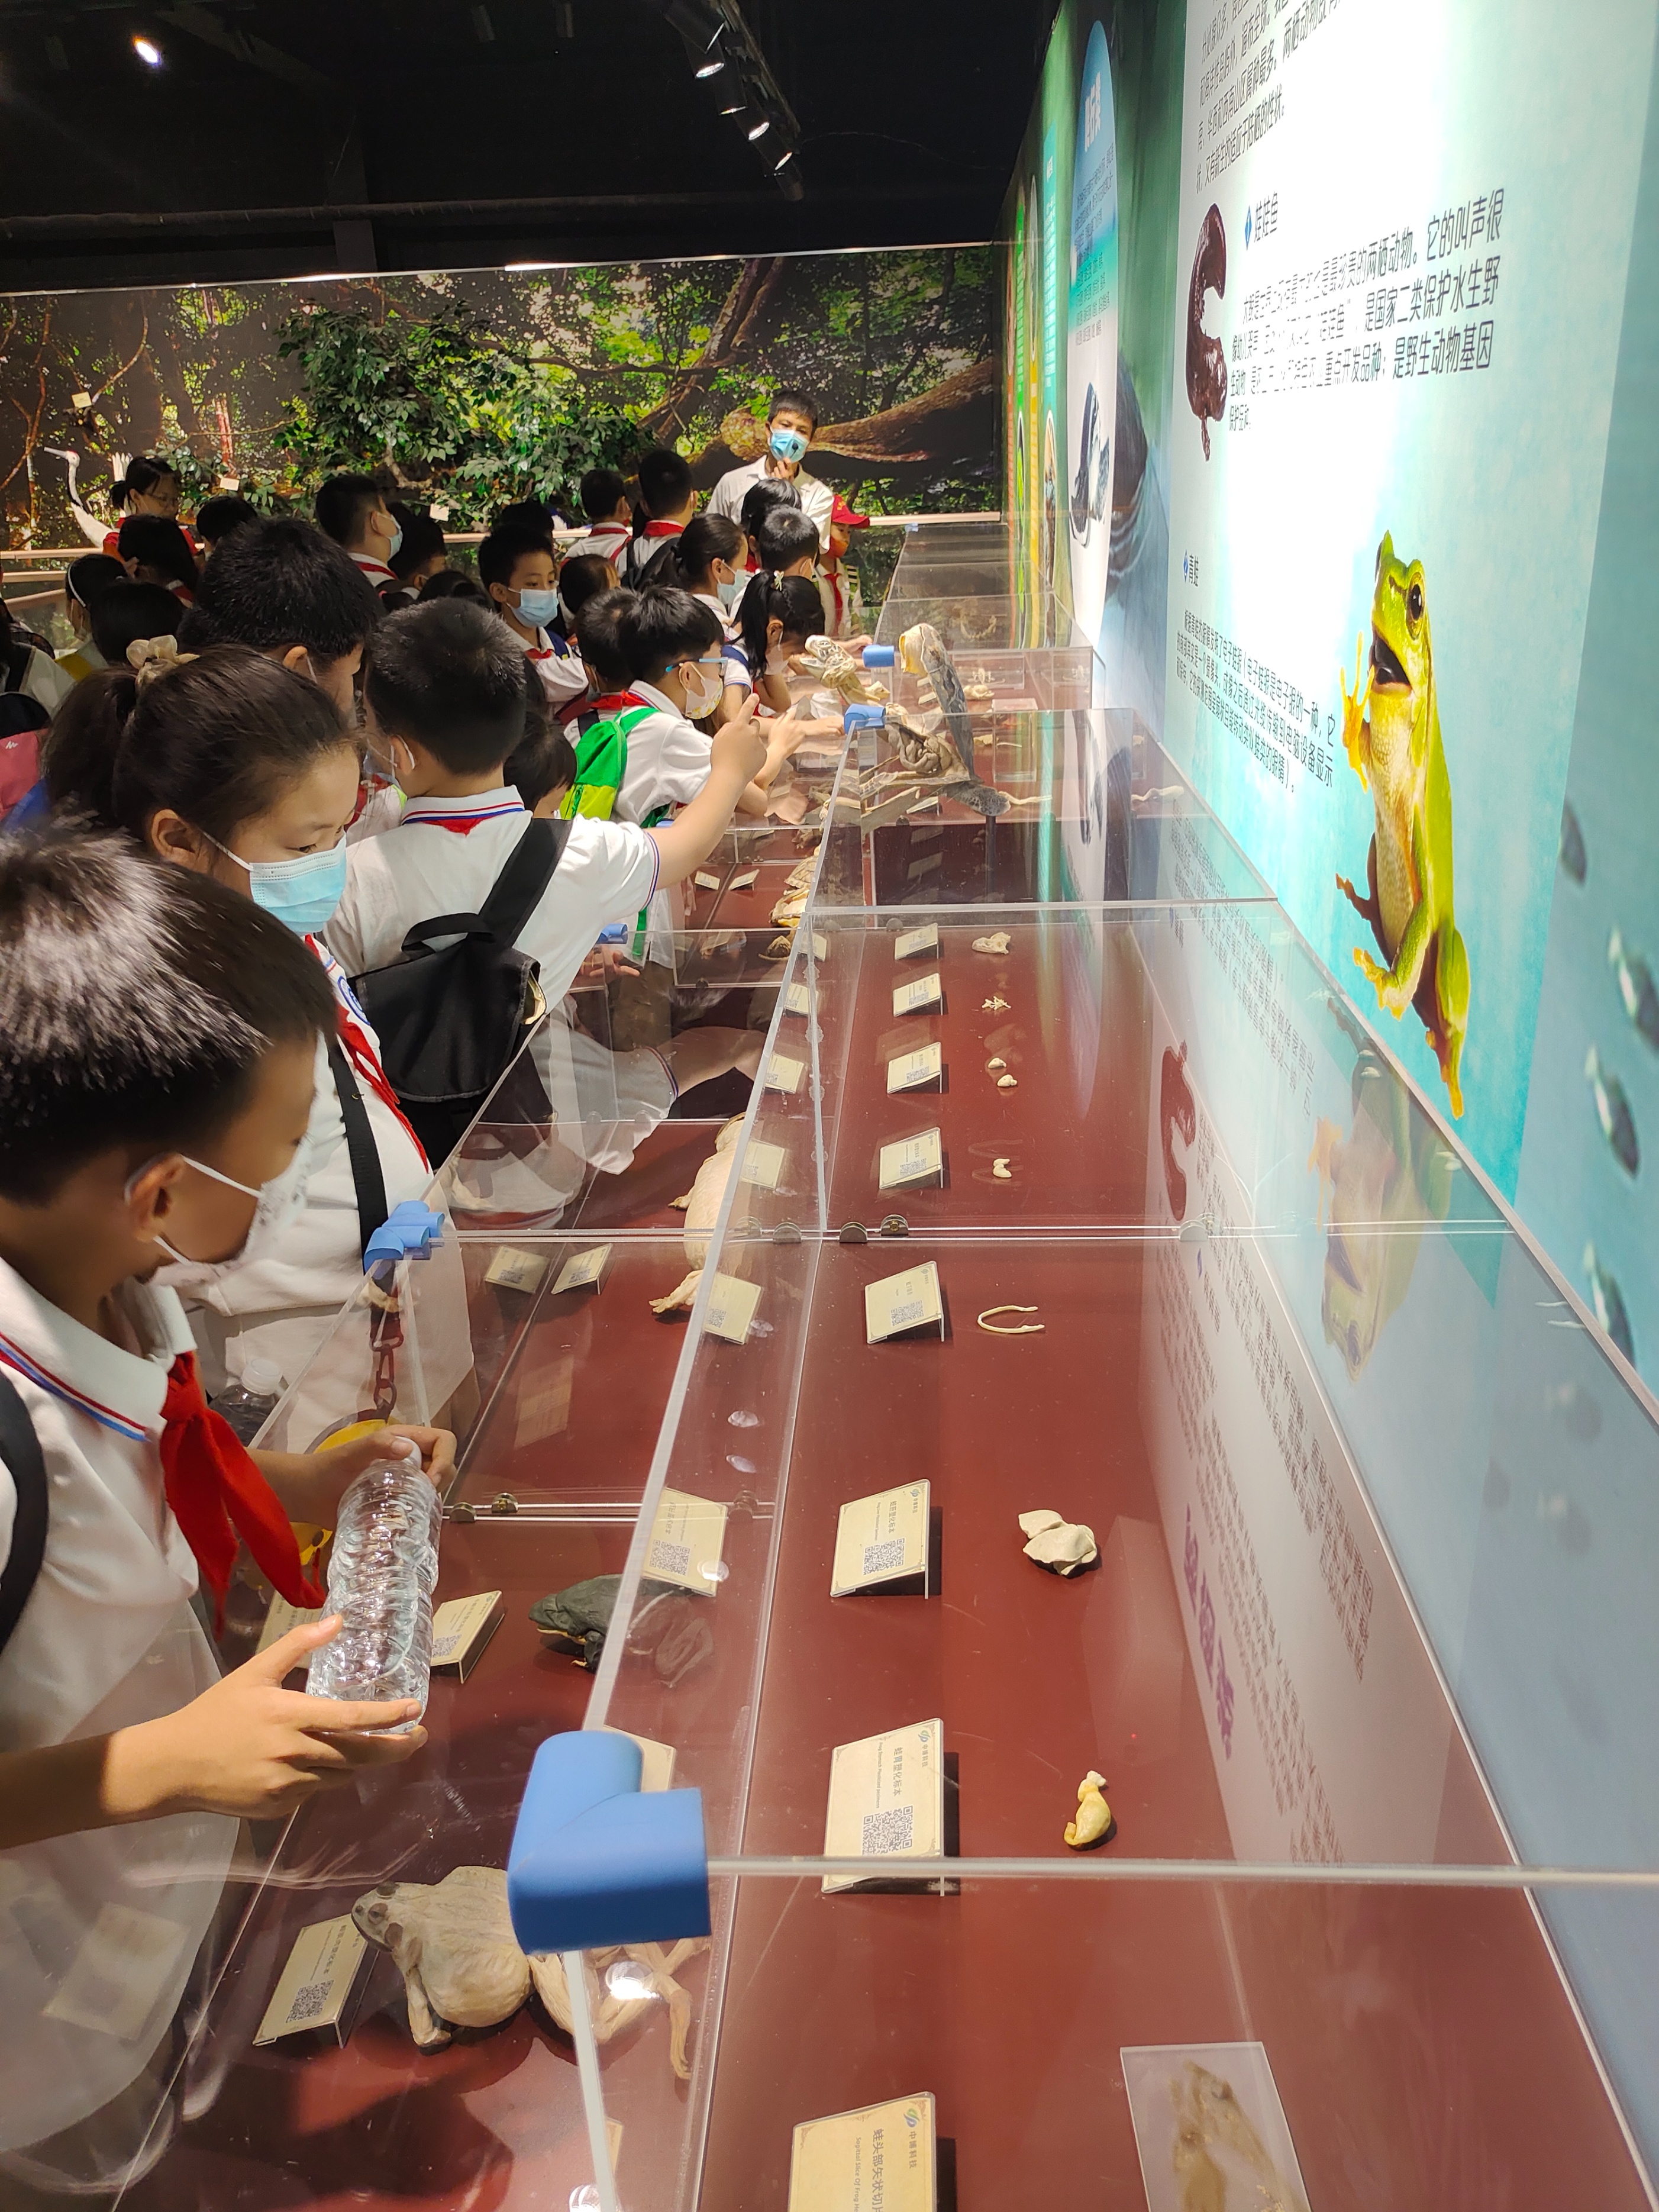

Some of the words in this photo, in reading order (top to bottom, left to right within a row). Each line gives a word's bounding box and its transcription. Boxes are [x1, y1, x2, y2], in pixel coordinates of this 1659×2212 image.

[1254, 192, 1279, 243] 娃娃鱼
[1189, 553, 1199, 586] 青蛙
[892, 1747, 903, 1797] 蛙胃塑化标本
[908, 2131, 918, 2169] 中博科技
[854, 2178, 861, 2187] Of
